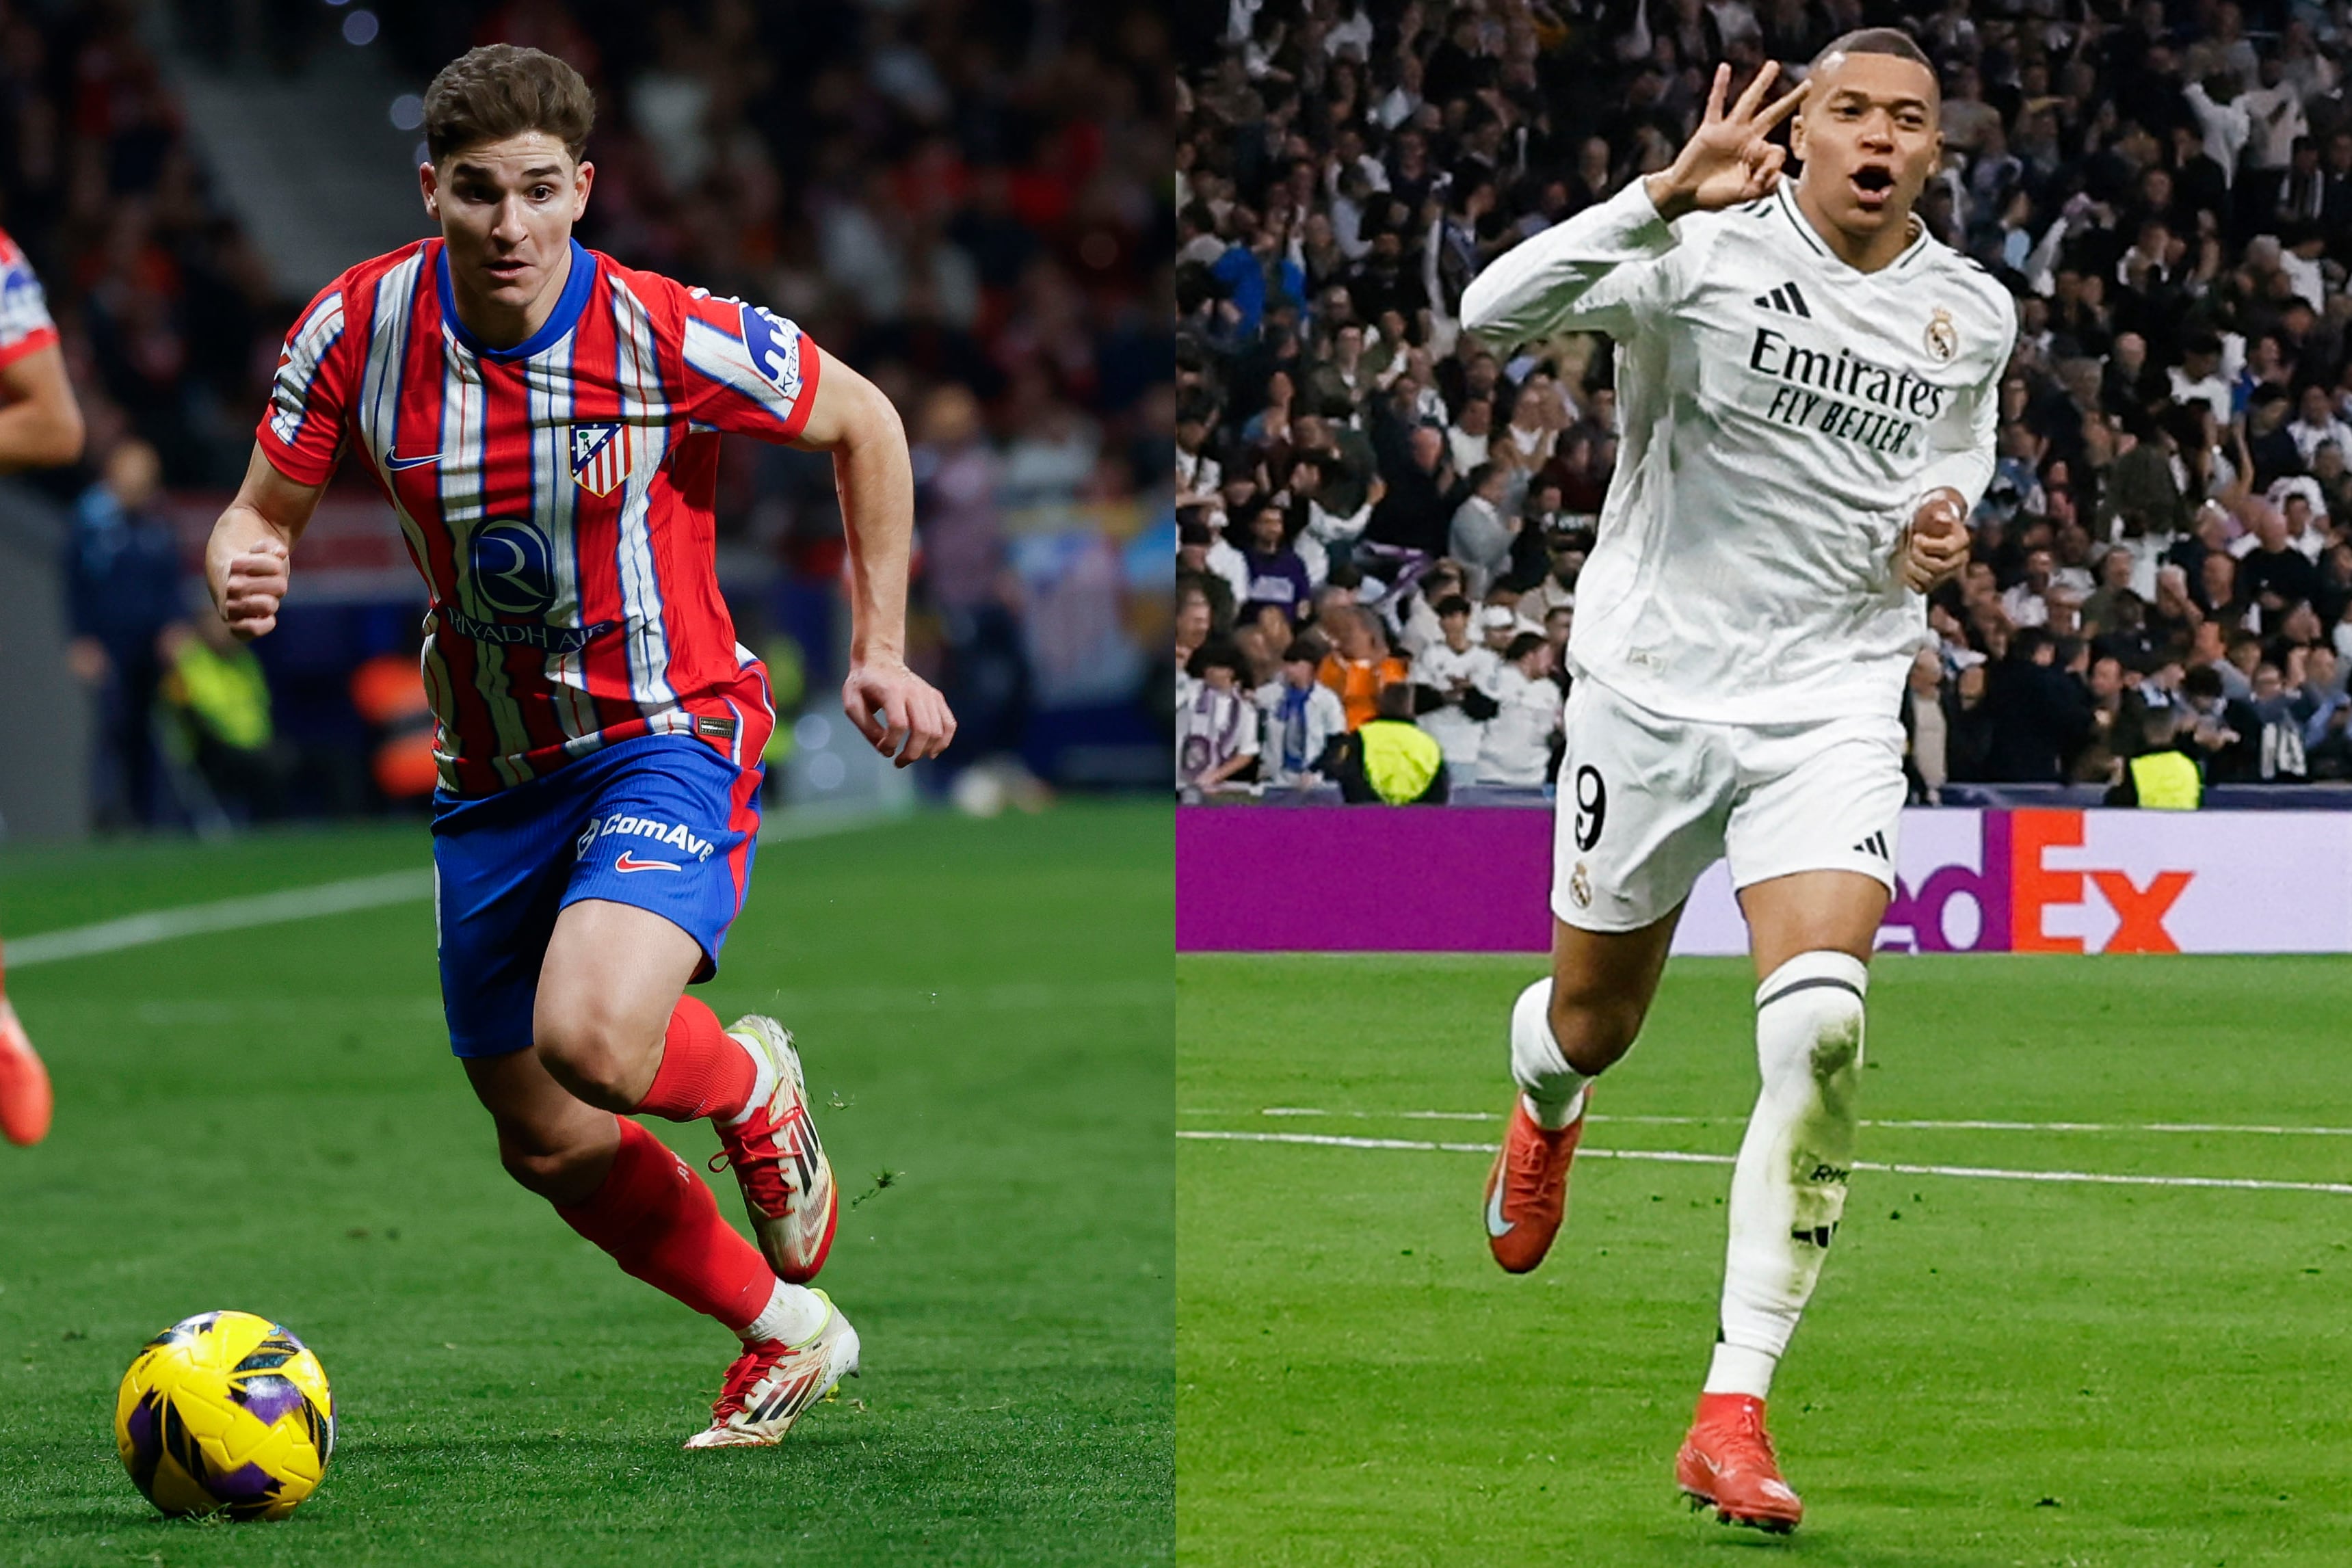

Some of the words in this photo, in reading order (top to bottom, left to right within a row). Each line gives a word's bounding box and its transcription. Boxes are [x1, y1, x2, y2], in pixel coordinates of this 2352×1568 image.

[778, 332, 797, 393] Krak
[1749, 326, 1944, 420] Emirates
[1767, 386, 1821, 425] FLY
[1819, 401, 1913, 455] BETTER
[447, 607, 547, 648] RIYADH
[558, 623, 605, 650] AIR
[1576, 765, 1607, 853] 9
